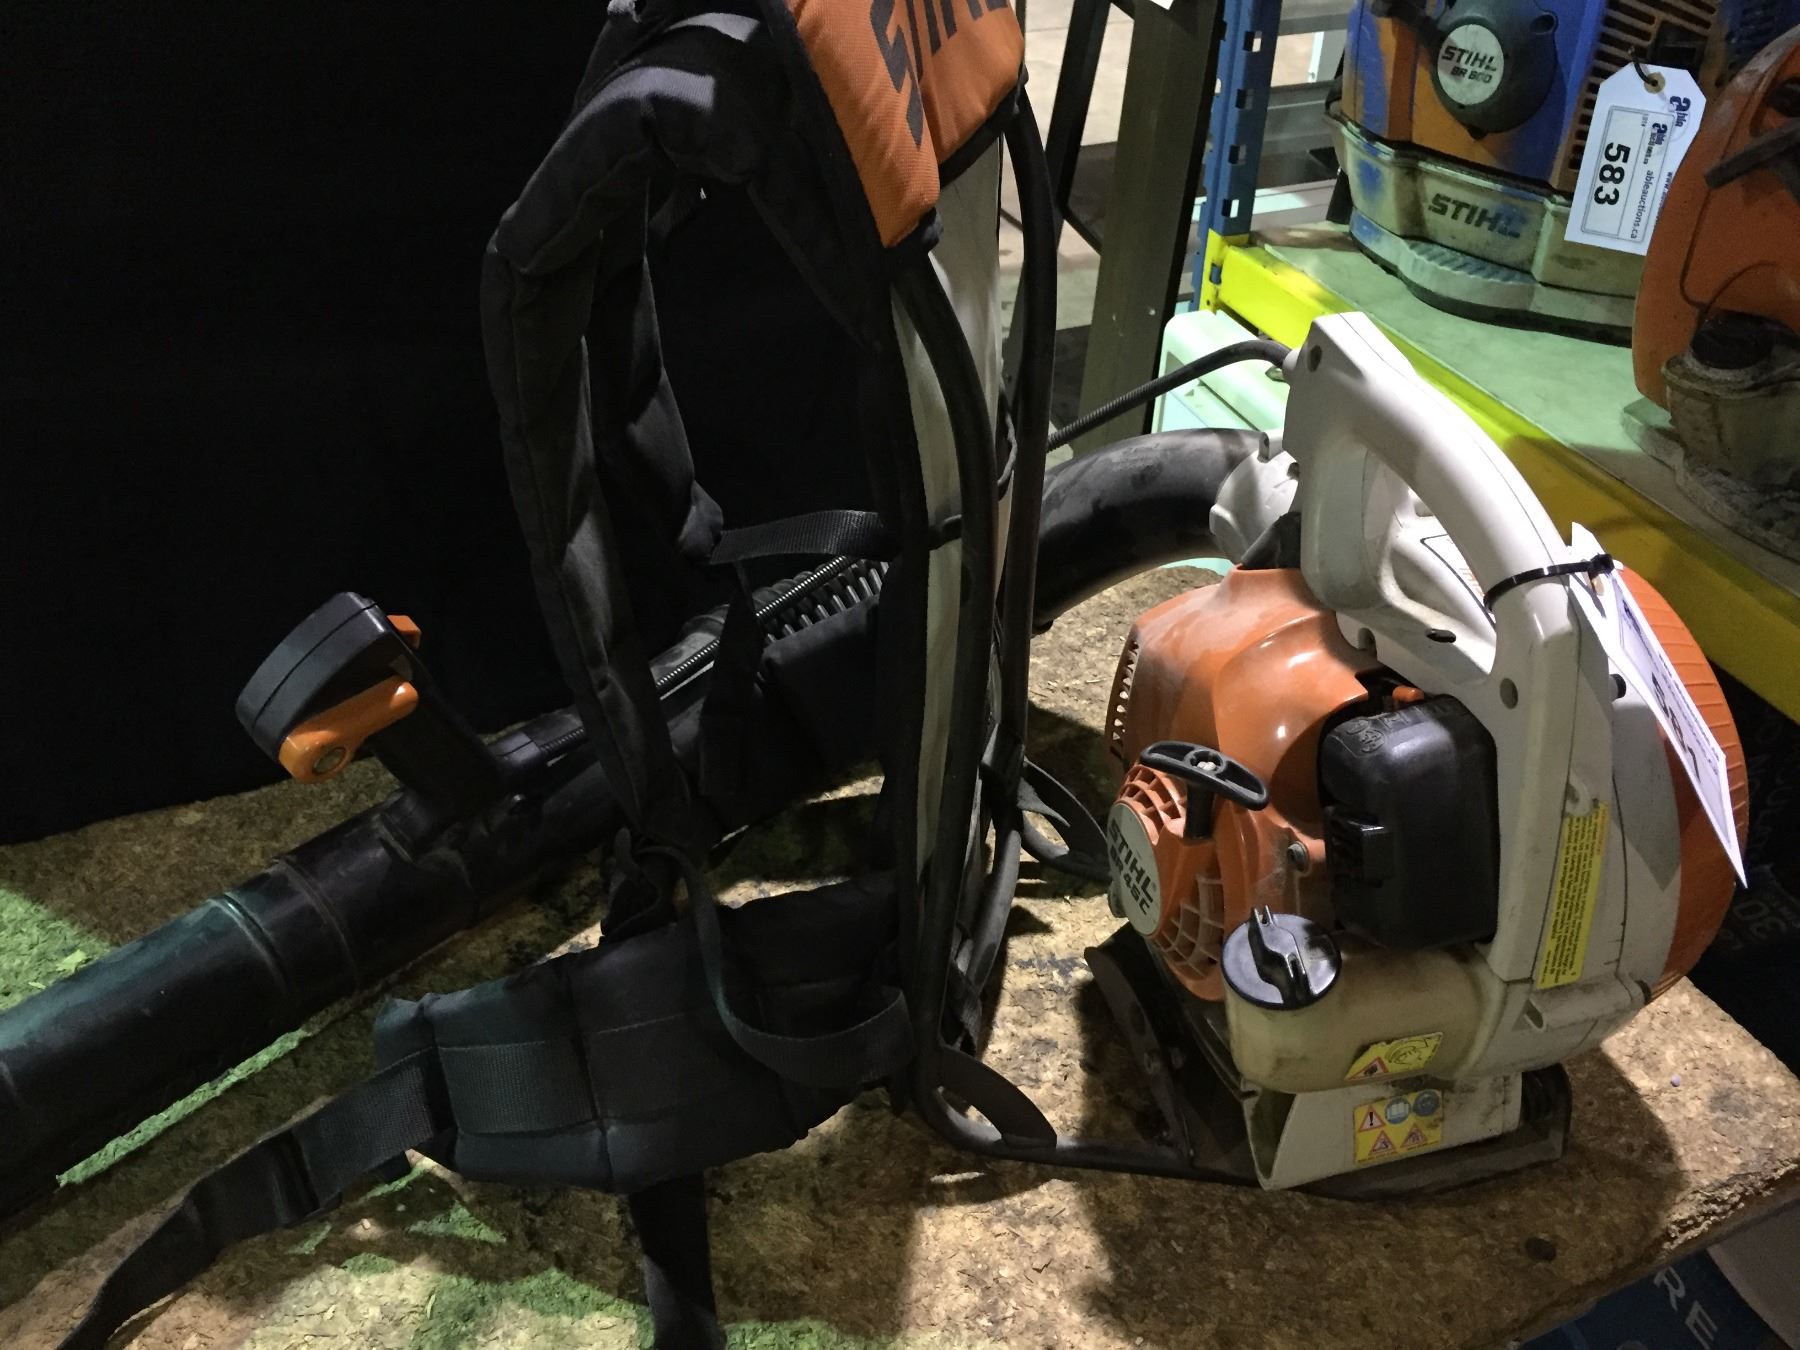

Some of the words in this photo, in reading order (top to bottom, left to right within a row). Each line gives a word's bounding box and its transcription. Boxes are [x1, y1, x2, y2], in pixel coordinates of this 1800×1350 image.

[1441, 45, 1497, 71] STIHL
[1450, 66, 1468, 78] BR
[1593, 142, 1631, 206] 583
[1428, 193, 1521, 239] STIHL
[1630, 170, 1654, 240] ableauctions.ca
[1108, 818, 1153, 903] STIHL
